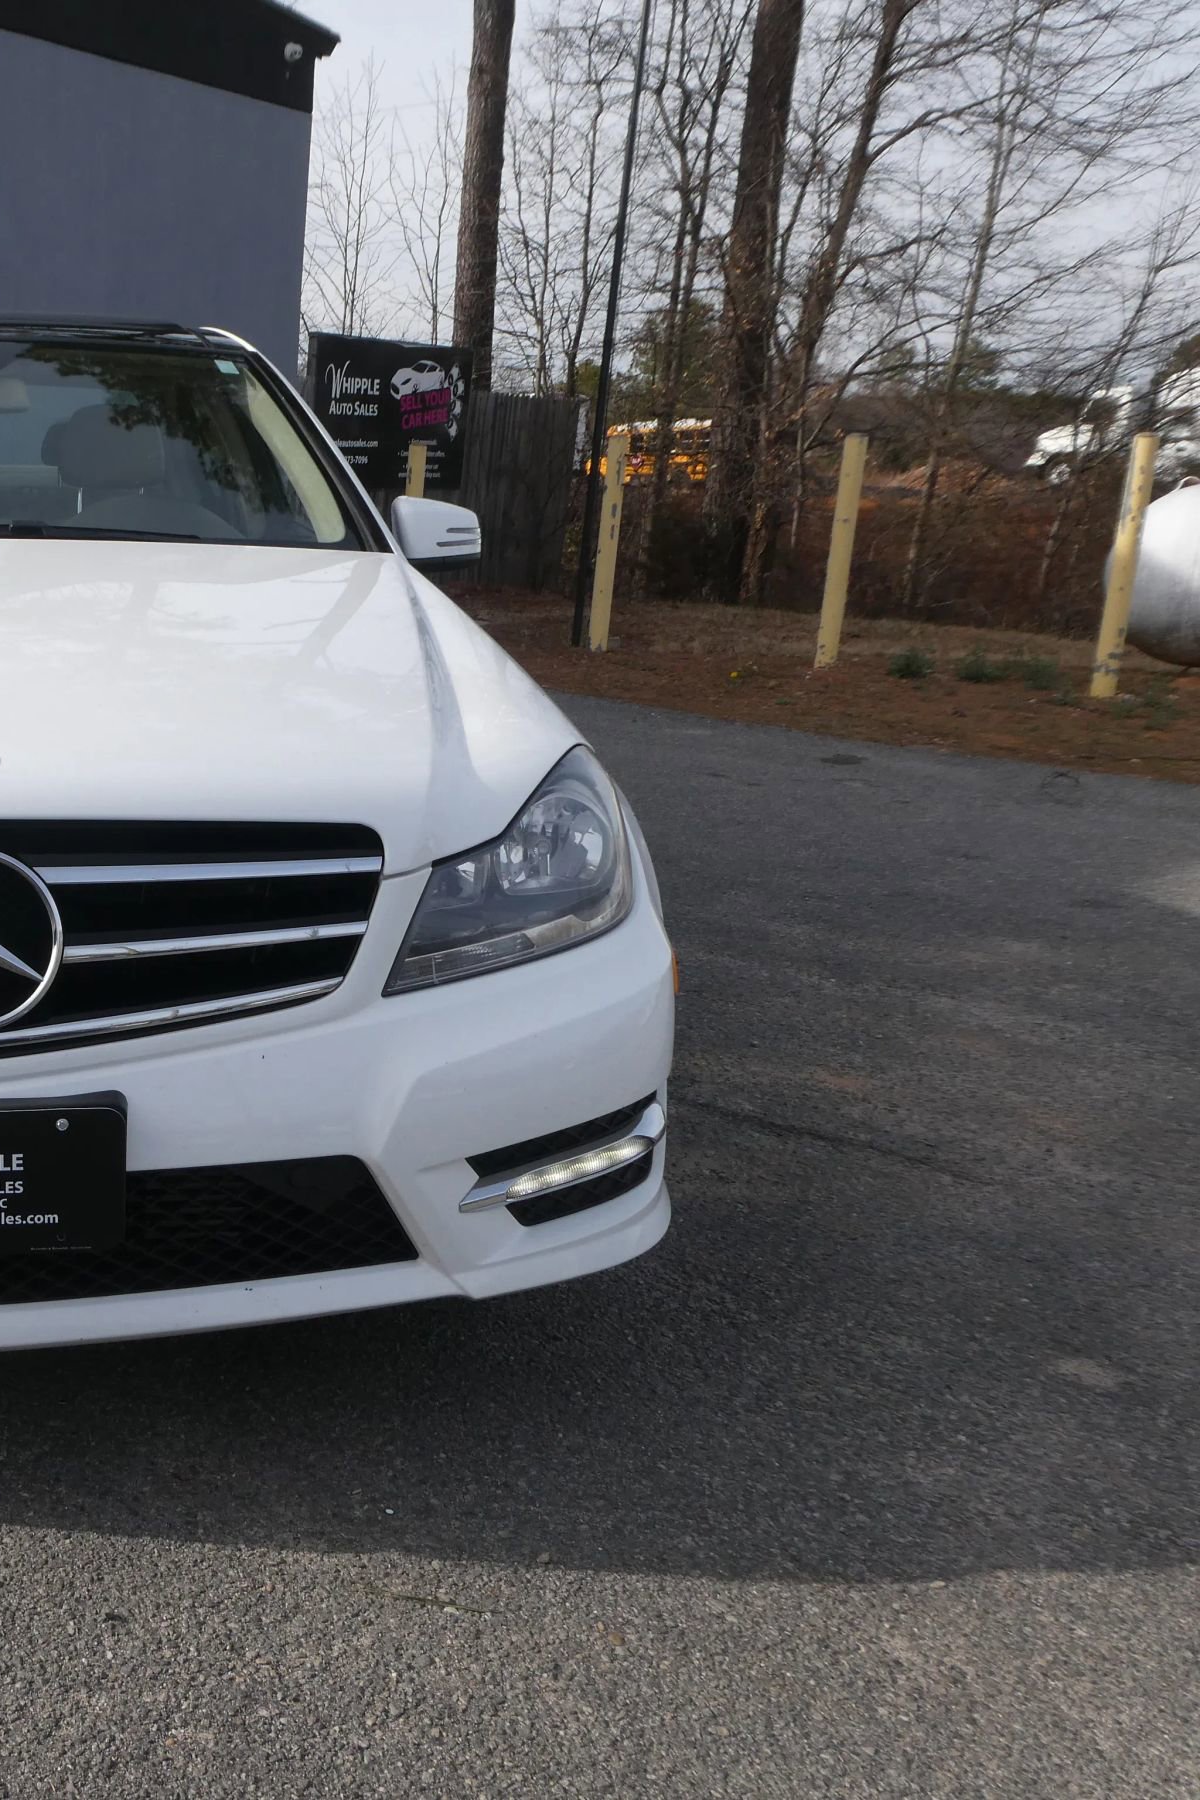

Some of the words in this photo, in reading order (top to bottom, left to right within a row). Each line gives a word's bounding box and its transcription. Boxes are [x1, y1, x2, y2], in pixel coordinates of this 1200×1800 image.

[325, 360, 380, 399] WHIPPLE
[329, 401, 353, 416] AUTO
[354, 401, 378, 416] SALES
